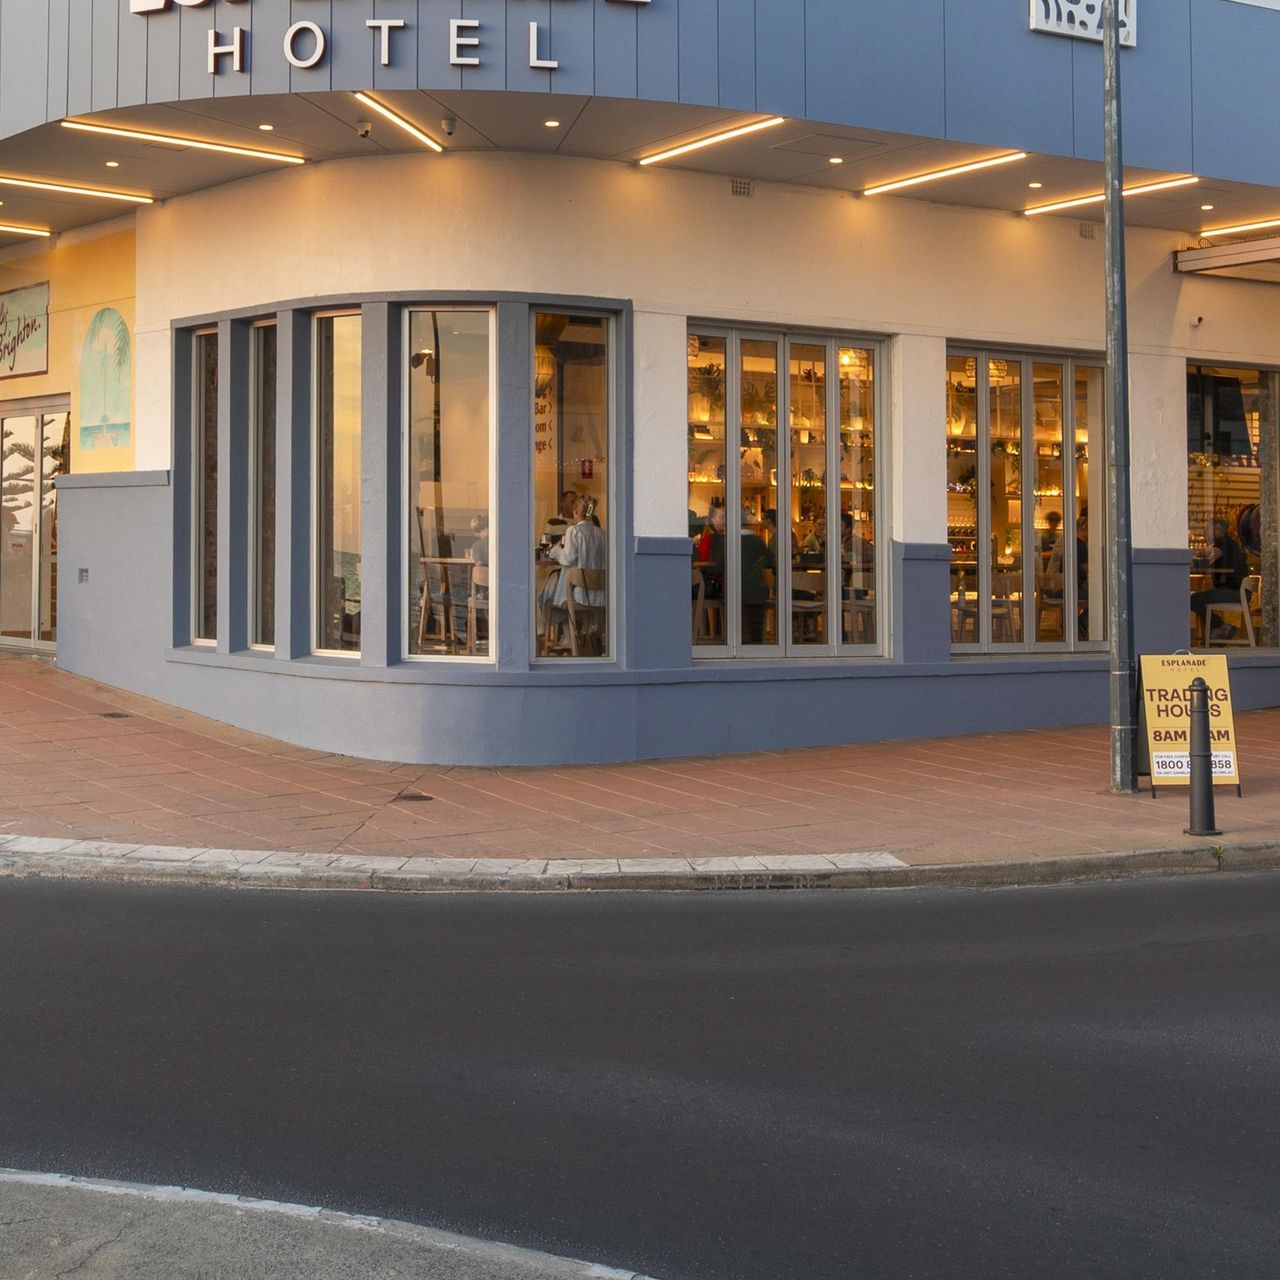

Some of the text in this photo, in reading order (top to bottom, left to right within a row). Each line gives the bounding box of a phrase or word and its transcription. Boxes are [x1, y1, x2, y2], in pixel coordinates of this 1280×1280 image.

[207, 18, 559, 75] HOTEL
[1161, 659, 1207, 667] ESPLANADE
[1157, 704, 1222, 718] HOUS
[1153, 730, 1188, 742] 8AM
[1156, 760, 1184, 770] 1800
